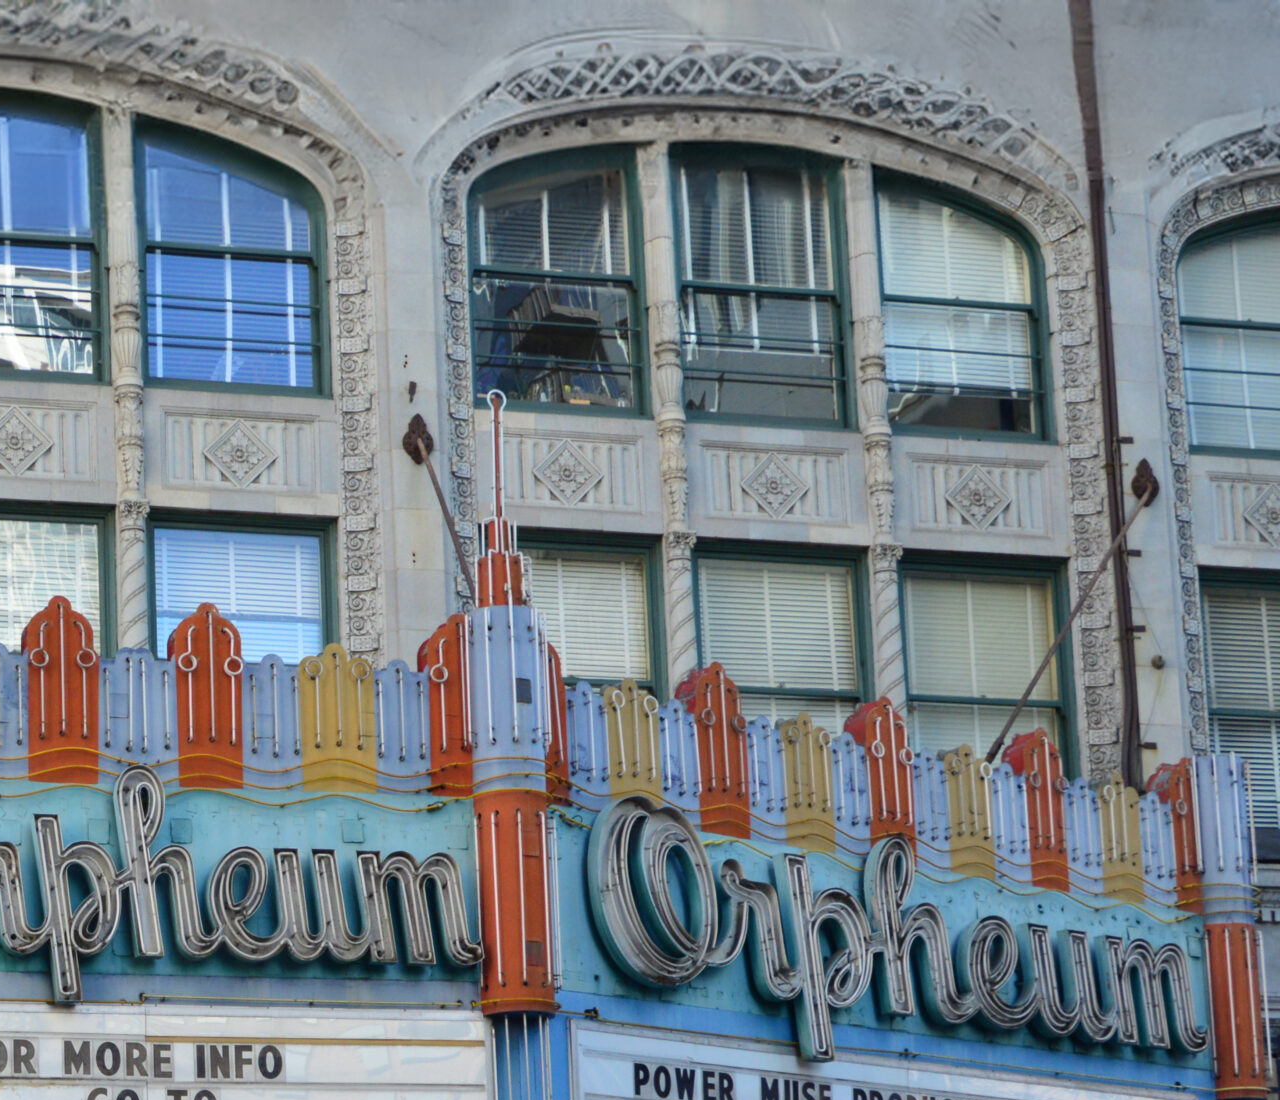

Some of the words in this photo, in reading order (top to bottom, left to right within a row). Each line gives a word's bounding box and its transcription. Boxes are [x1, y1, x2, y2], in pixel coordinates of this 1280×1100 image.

[588, 797, 1208, 1062] Orpheum
[64, 1041, 173, 1078] MORE
[196, 1044, 283, 1079] INFO
